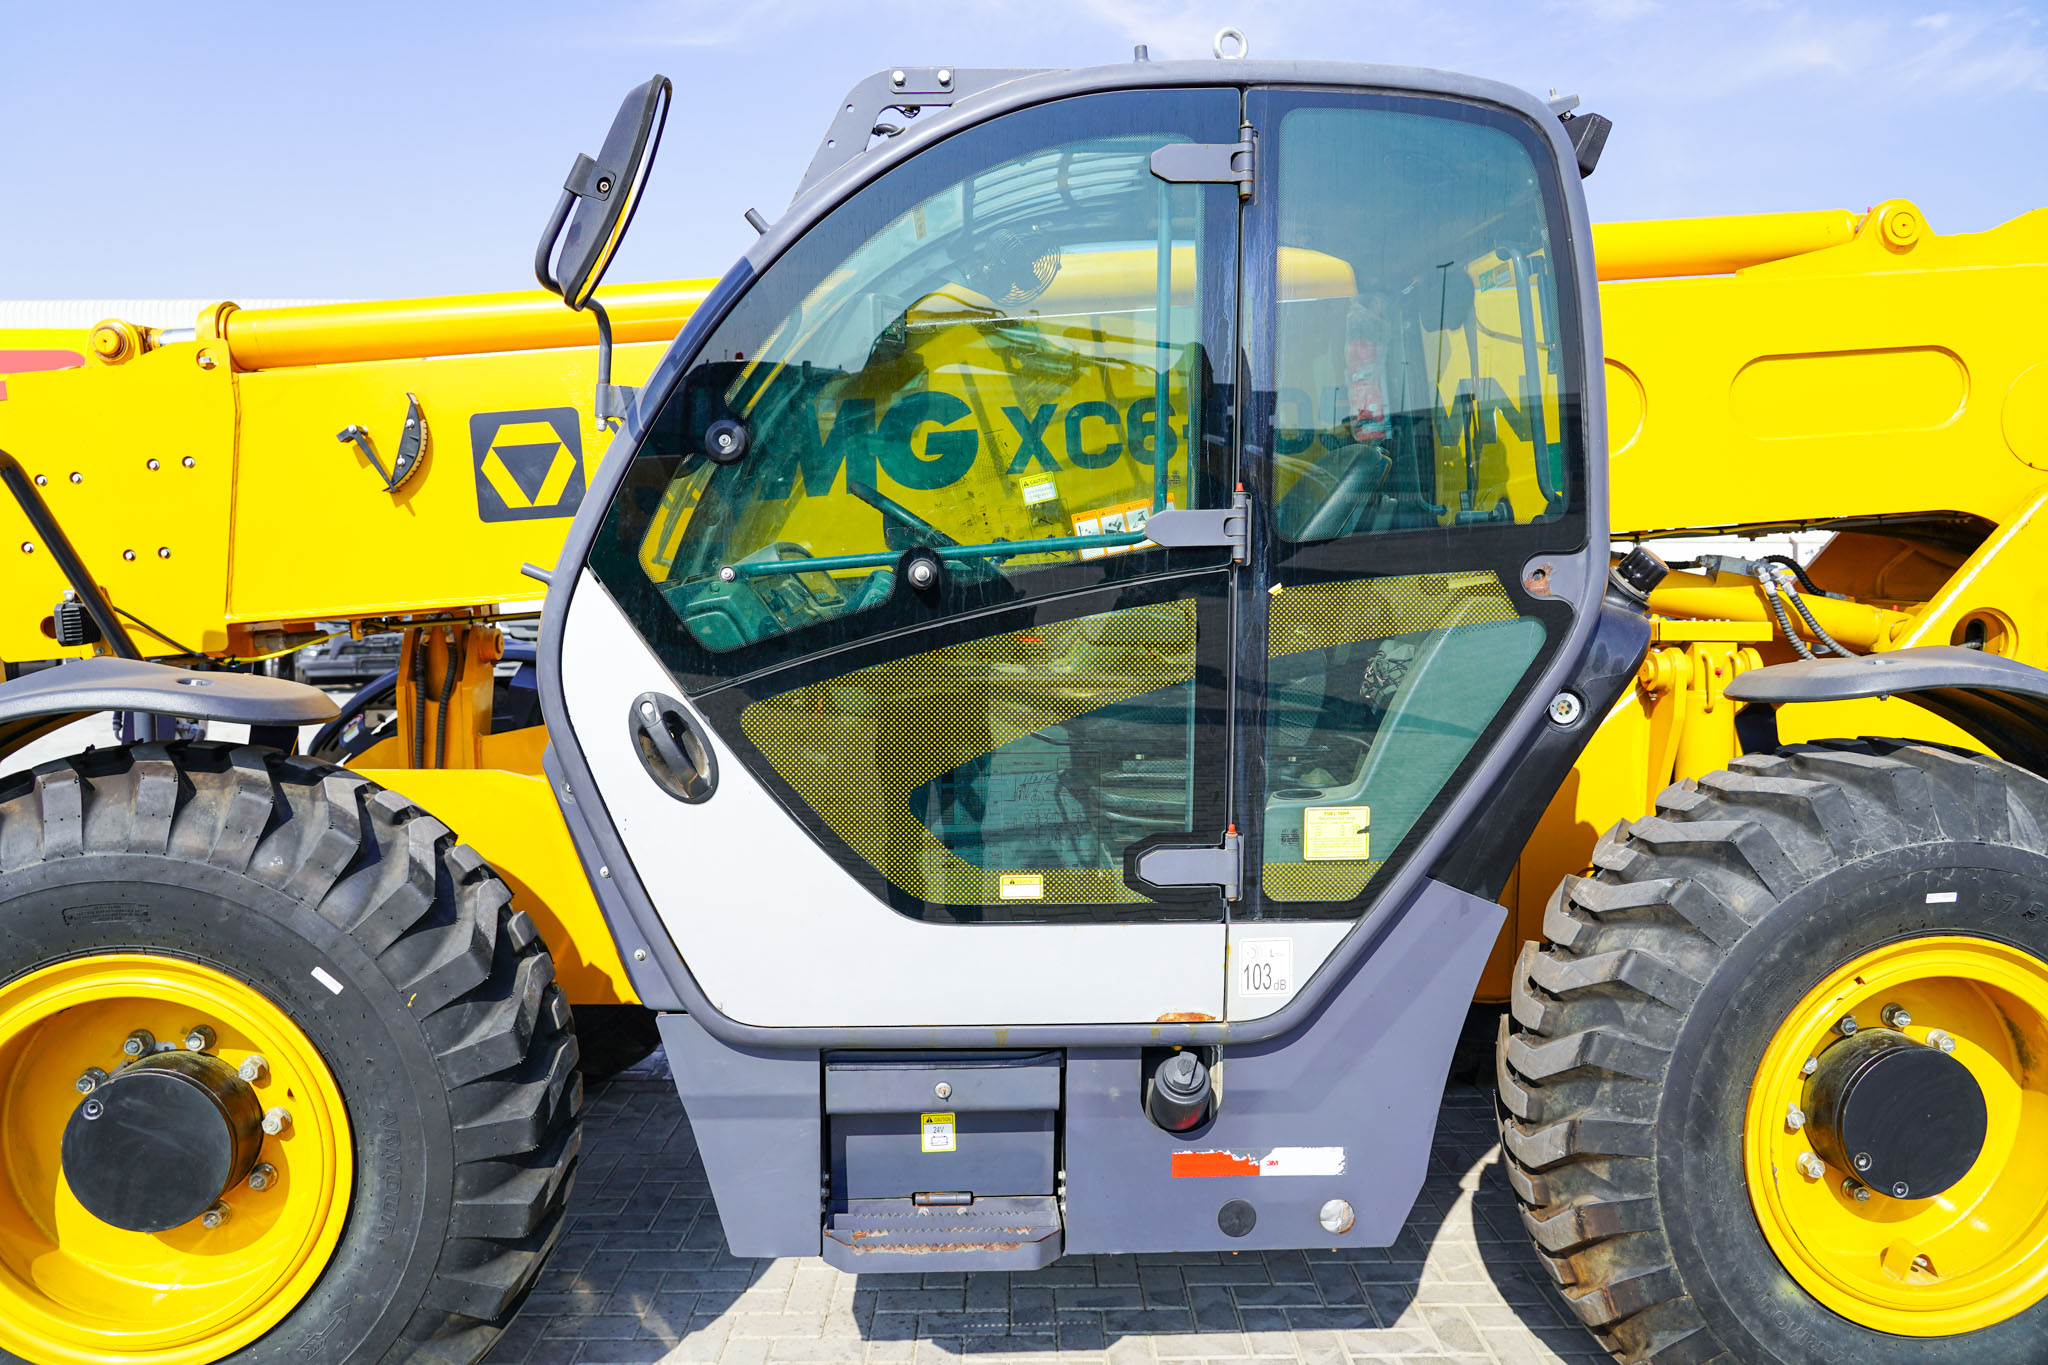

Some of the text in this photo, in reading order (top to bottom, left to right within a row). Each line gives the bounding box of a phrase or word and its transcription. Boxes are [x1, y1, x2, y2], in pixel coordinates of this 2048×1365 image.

[1243, 963, 1287, 990] 103 dB
[933, 1126, 945, 1134] 24V
